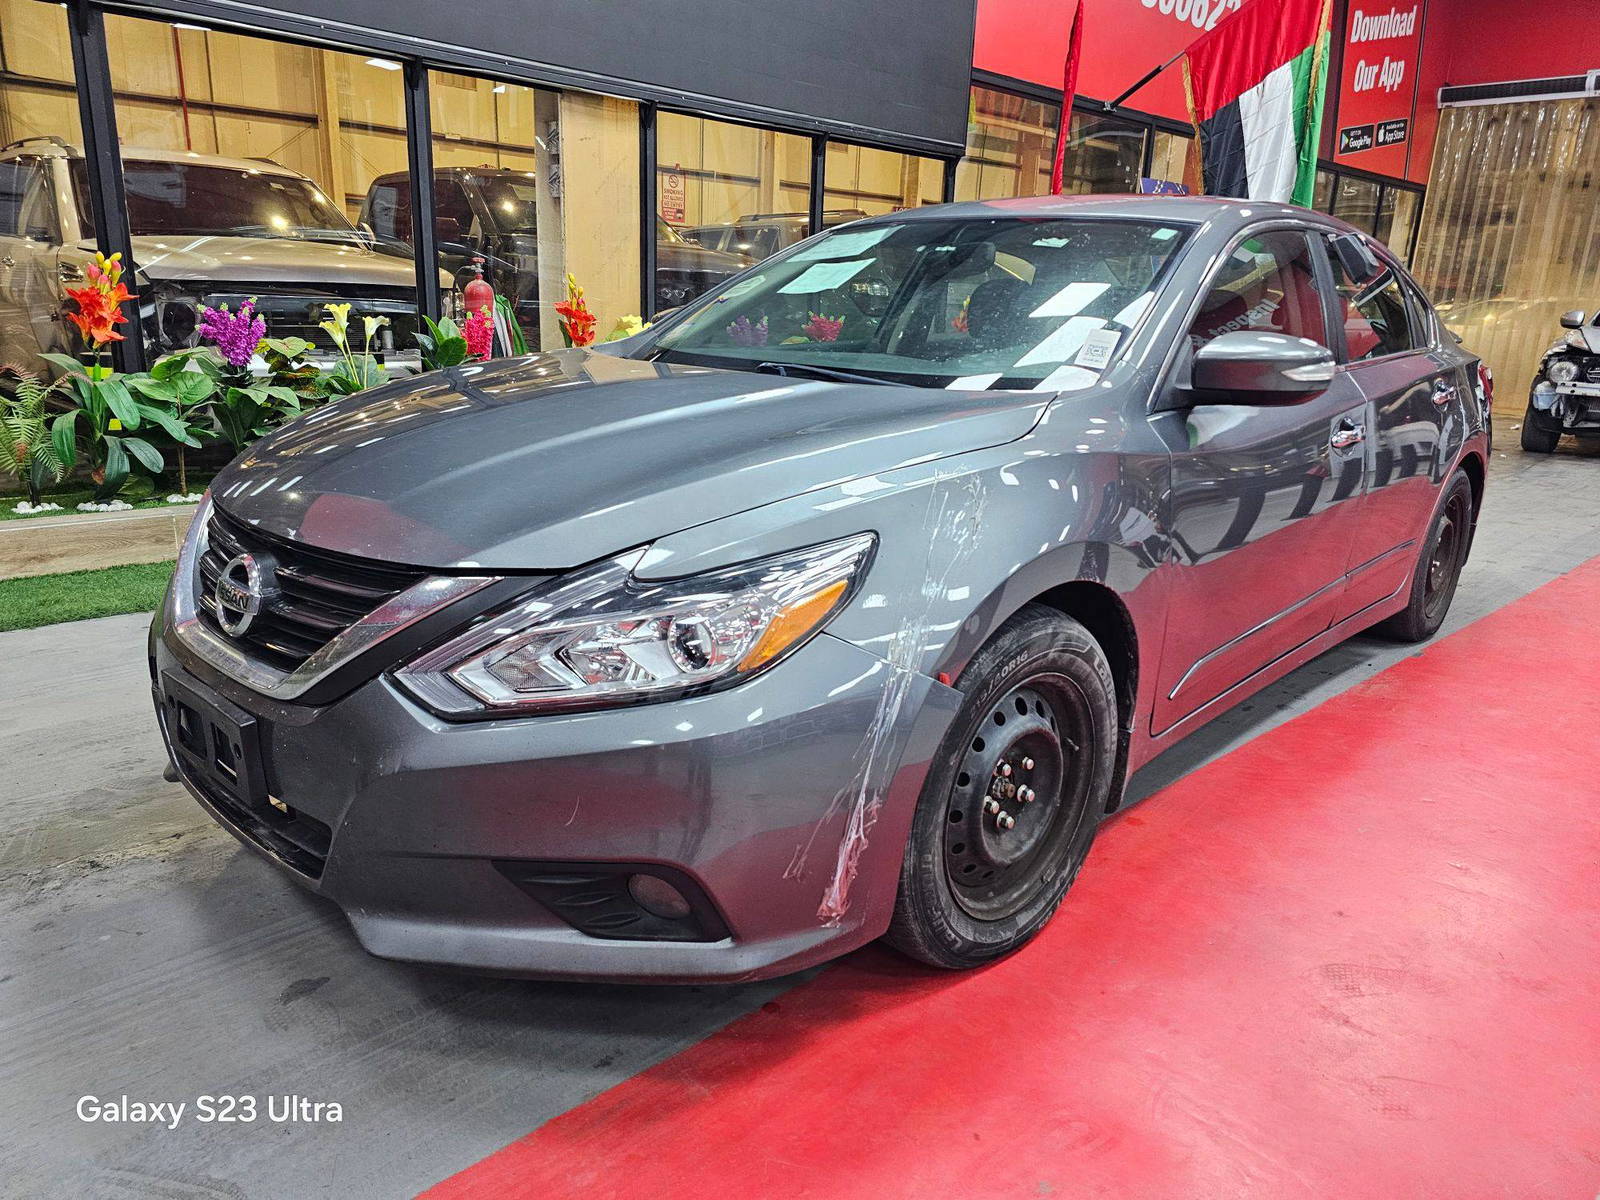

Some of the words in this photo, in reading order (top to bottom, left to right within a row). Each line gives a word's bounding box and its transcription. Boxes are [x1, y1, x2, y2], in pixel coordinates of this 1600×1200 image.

[1350, 5, 1417, 43] Download
[1353, 59, 1379, 93] Our
[1378, 56, 1405, 93] App
[1349, 138, 1363, 149] Google
[1363, 135, 1371, 147] Play
[1385, 132, 1394, 143] App
[1394, 130, 1404, 140] Store
